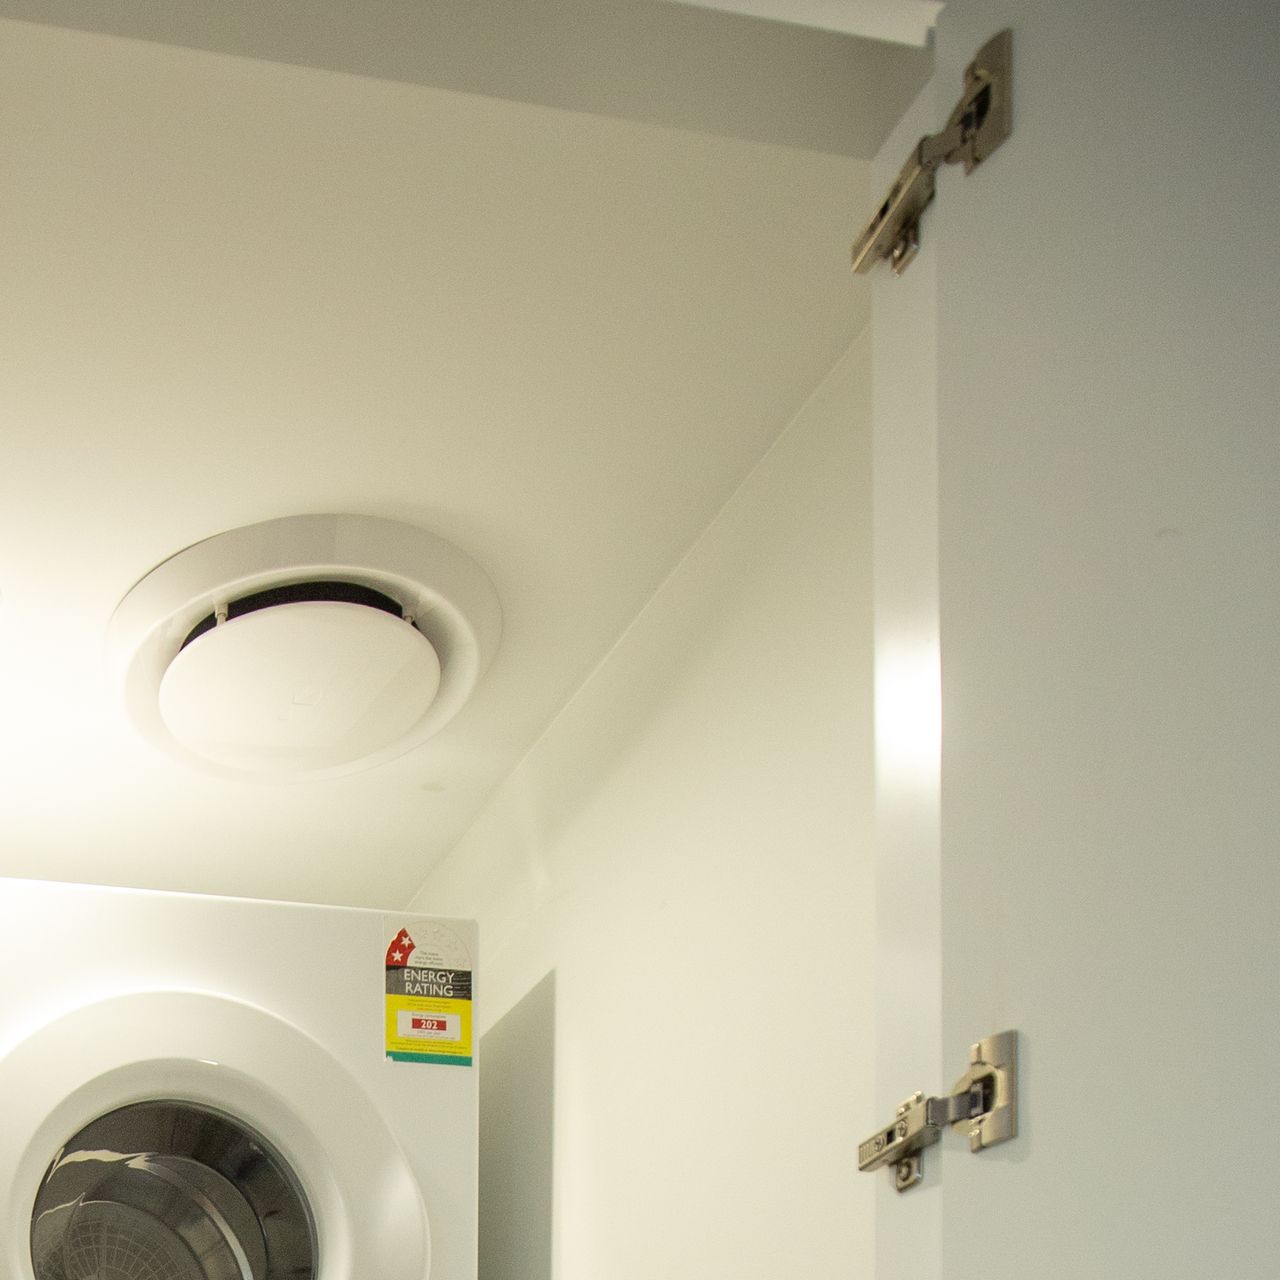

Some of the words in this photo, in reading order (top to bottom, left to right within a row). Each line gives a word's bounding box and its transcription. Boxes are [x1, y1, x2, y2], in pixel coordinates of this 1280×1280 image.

[404, 969, 455, 984] ENERGY
[405, 981, 454, 997] RATING
[420, 1020, 438, 1030] 202
